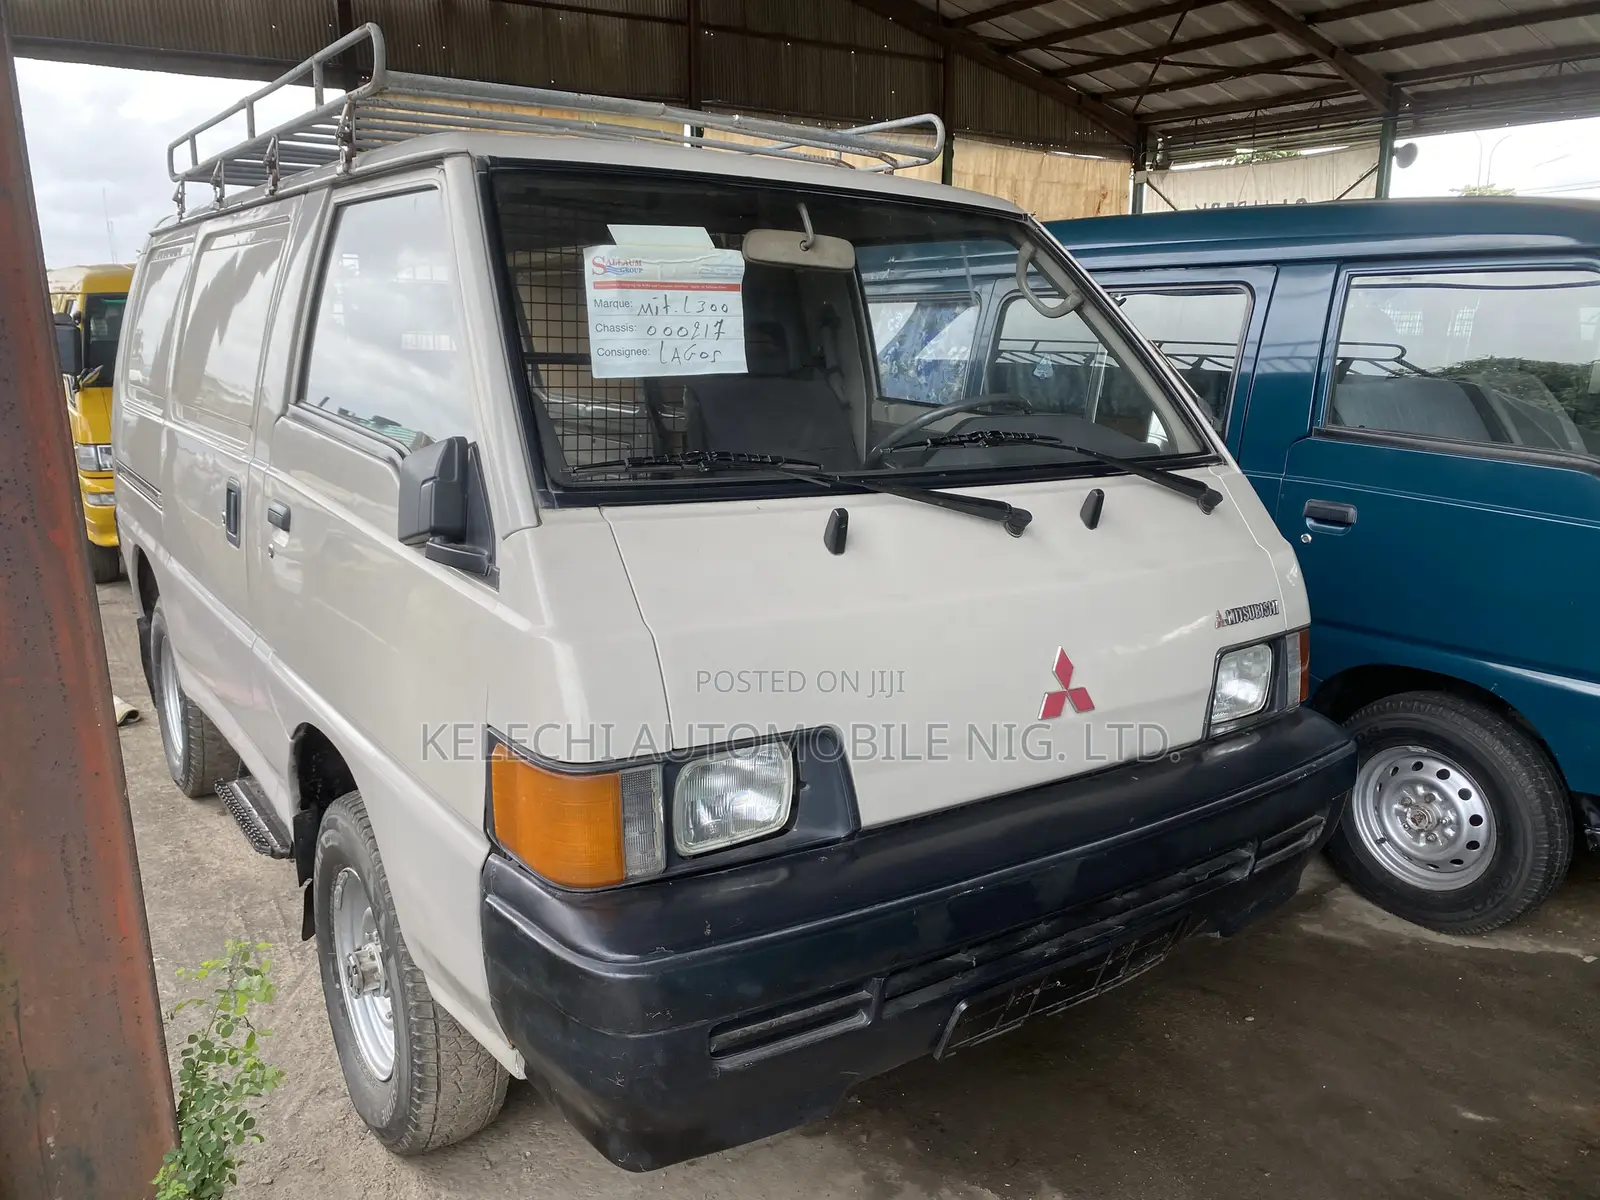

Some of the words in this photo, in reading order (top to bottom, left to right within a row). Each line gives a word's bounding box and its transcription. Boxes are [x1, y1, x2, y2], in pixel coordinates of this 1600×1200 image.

[594, 299, 632, 310] Marque:
[684, 296, 729, 313] L300
[595, 323, 637, 333] Chassis:
[597, 347, 651, 358] Consignee:
[1225, 600, 1279, 625] MITSUBISHI
